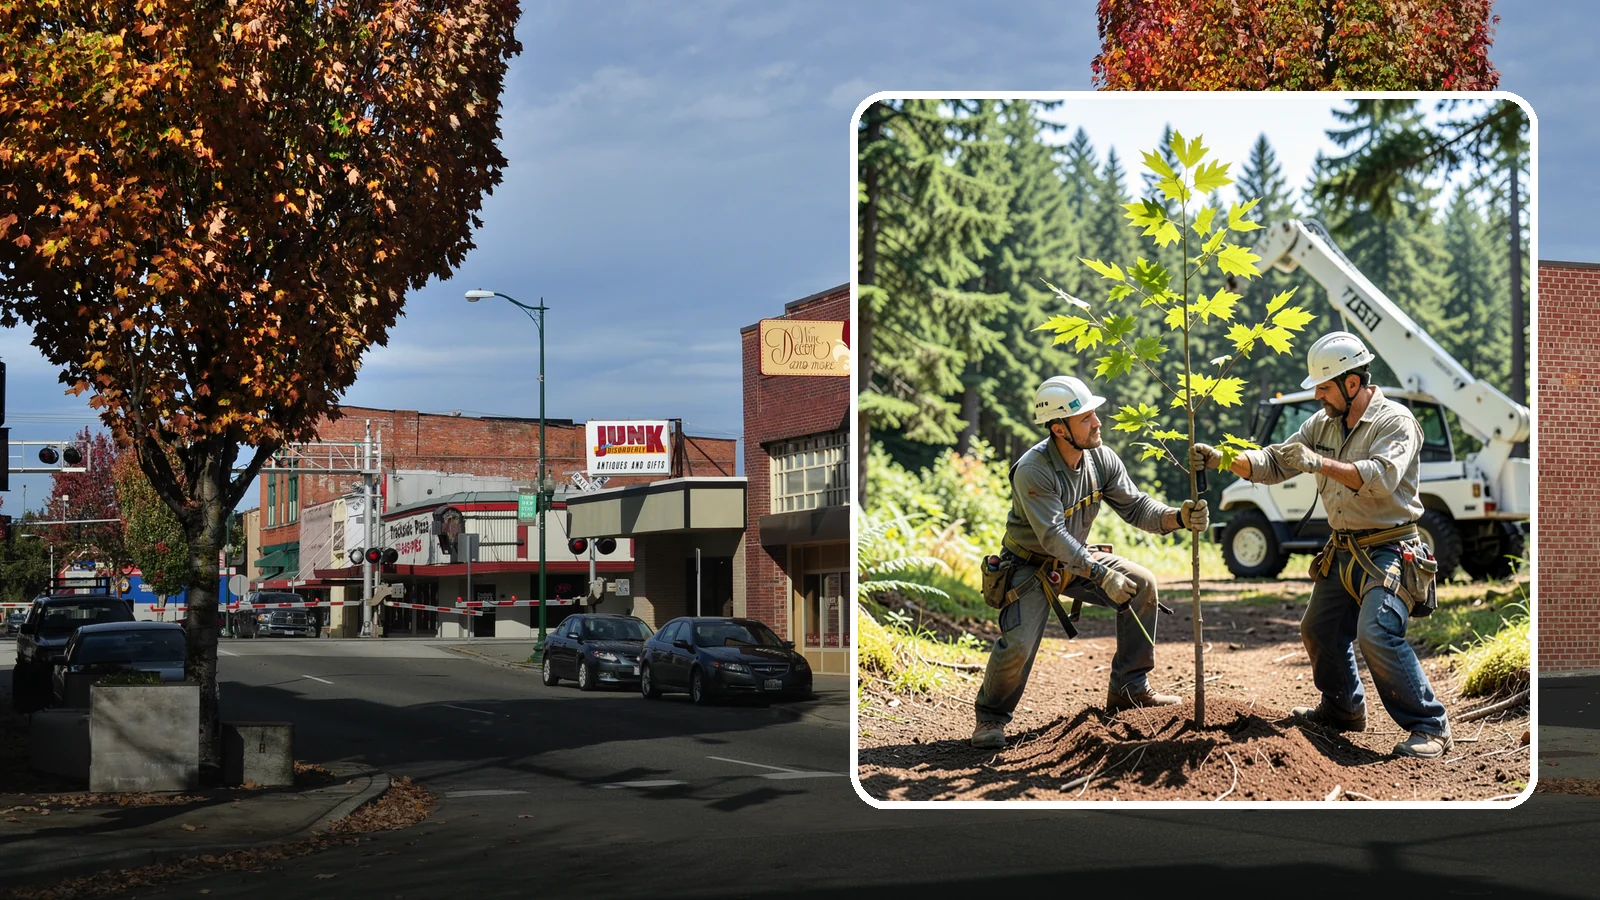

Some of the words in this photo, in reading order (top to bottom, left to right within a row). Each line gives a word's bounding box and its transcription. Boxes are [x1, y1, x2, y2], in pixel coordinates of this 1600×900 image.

[596, 425, 664, 457] JUNK
[607, 446, 646, 454] DISORDERLY
[597, 461, 628, 470] ANTIQUES
[631, 461, 644, 470] AND
[647, 460, 665, 469] GIFTS
[415, 519, 429, 534] Pizza
